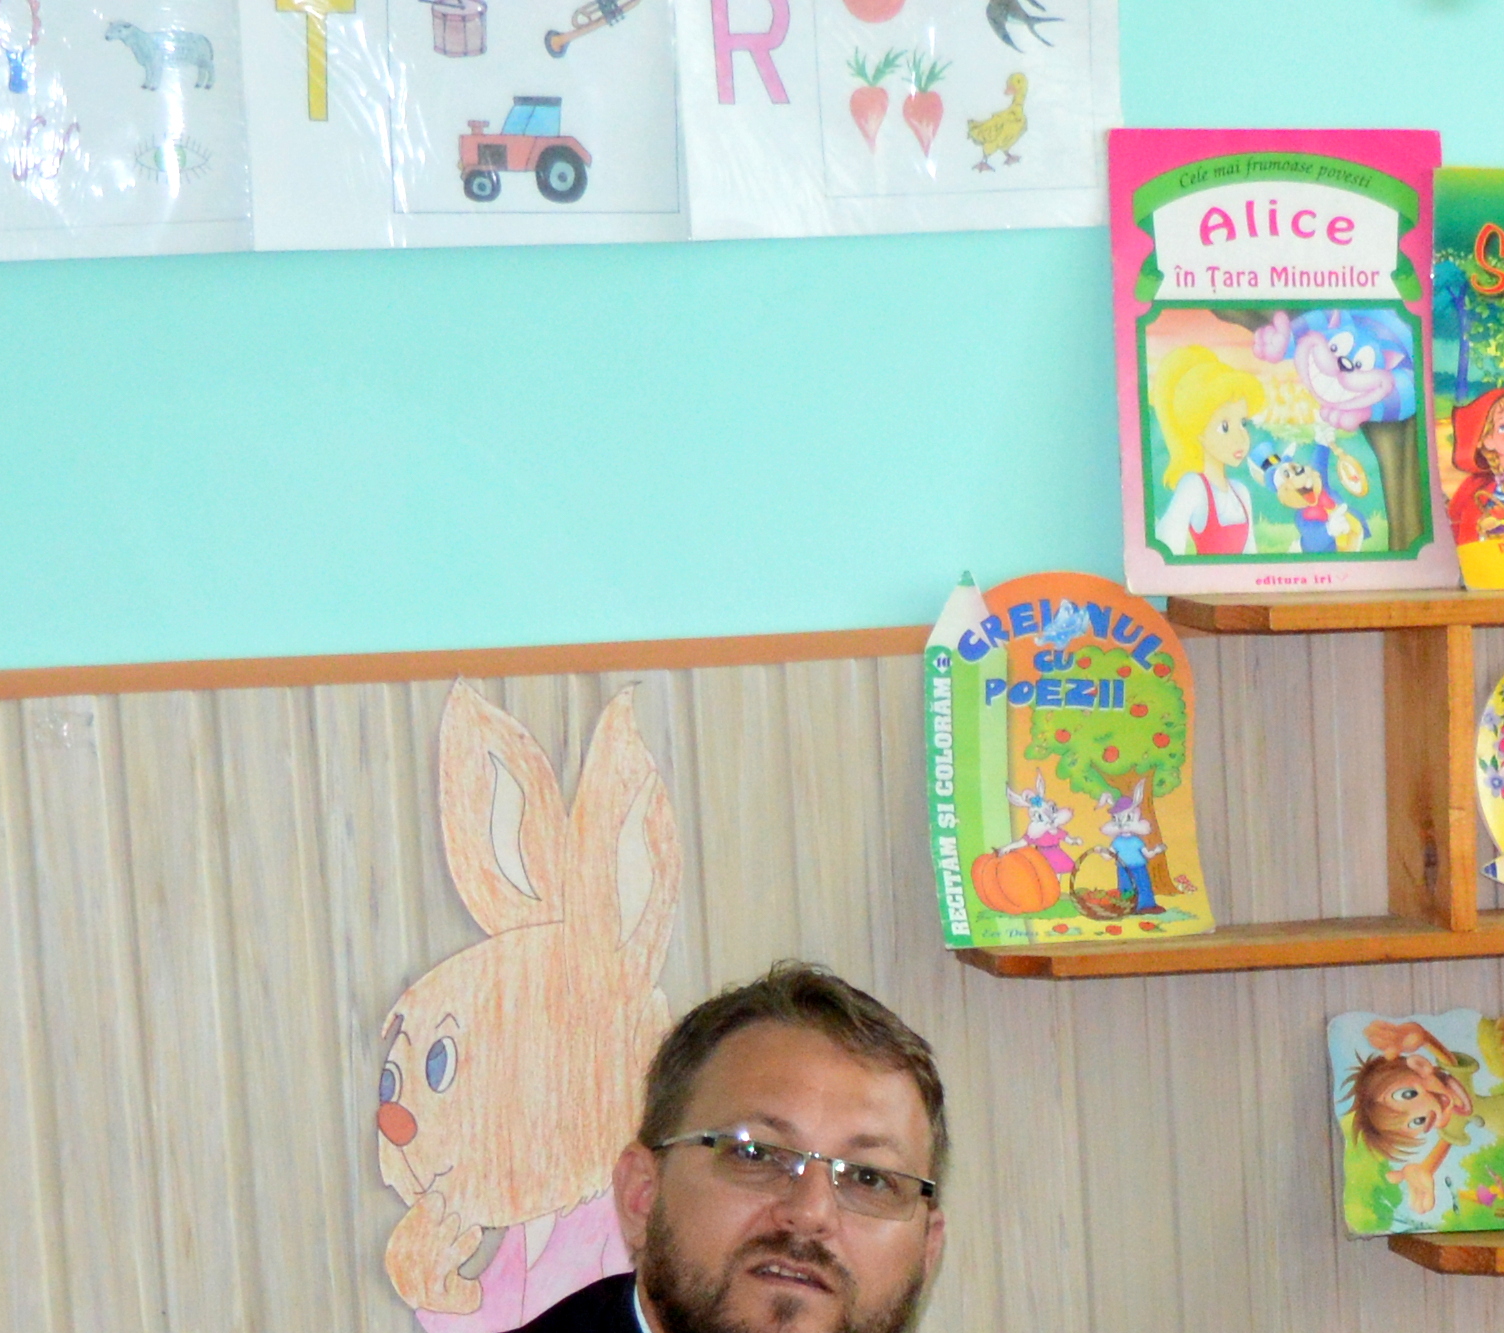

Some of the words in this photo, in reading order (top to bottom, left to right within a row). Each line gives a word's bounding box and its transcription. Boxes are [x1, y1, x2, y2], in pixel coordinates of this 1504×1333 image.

[275, 0, 357, 122] T
[709, 0, 792, 106] R
[1179, 165, 1208, 188] Cele
[1214, 160, 1241, 177] mai
[1246, 157, 1314, 176] frumoase
[1199, 198, 1356, 247] Alice
[1174, 264, 1196, 288] în
[1206, 266, 1259, 294] Țara
[1270, 265, 1381, 288] Minunilor
[1255, 575, 1308, 586] editura
[956, 598, 1164, 671] CREINUL
[1033, 649, 1075, 673] CU
[985, 678, 1126, 710] POEZII
[933, 677, 955, 798] COLORĂM
[937, 803, 960, 829] ȘI
[942, 836, 971, 936] RECITĂM
